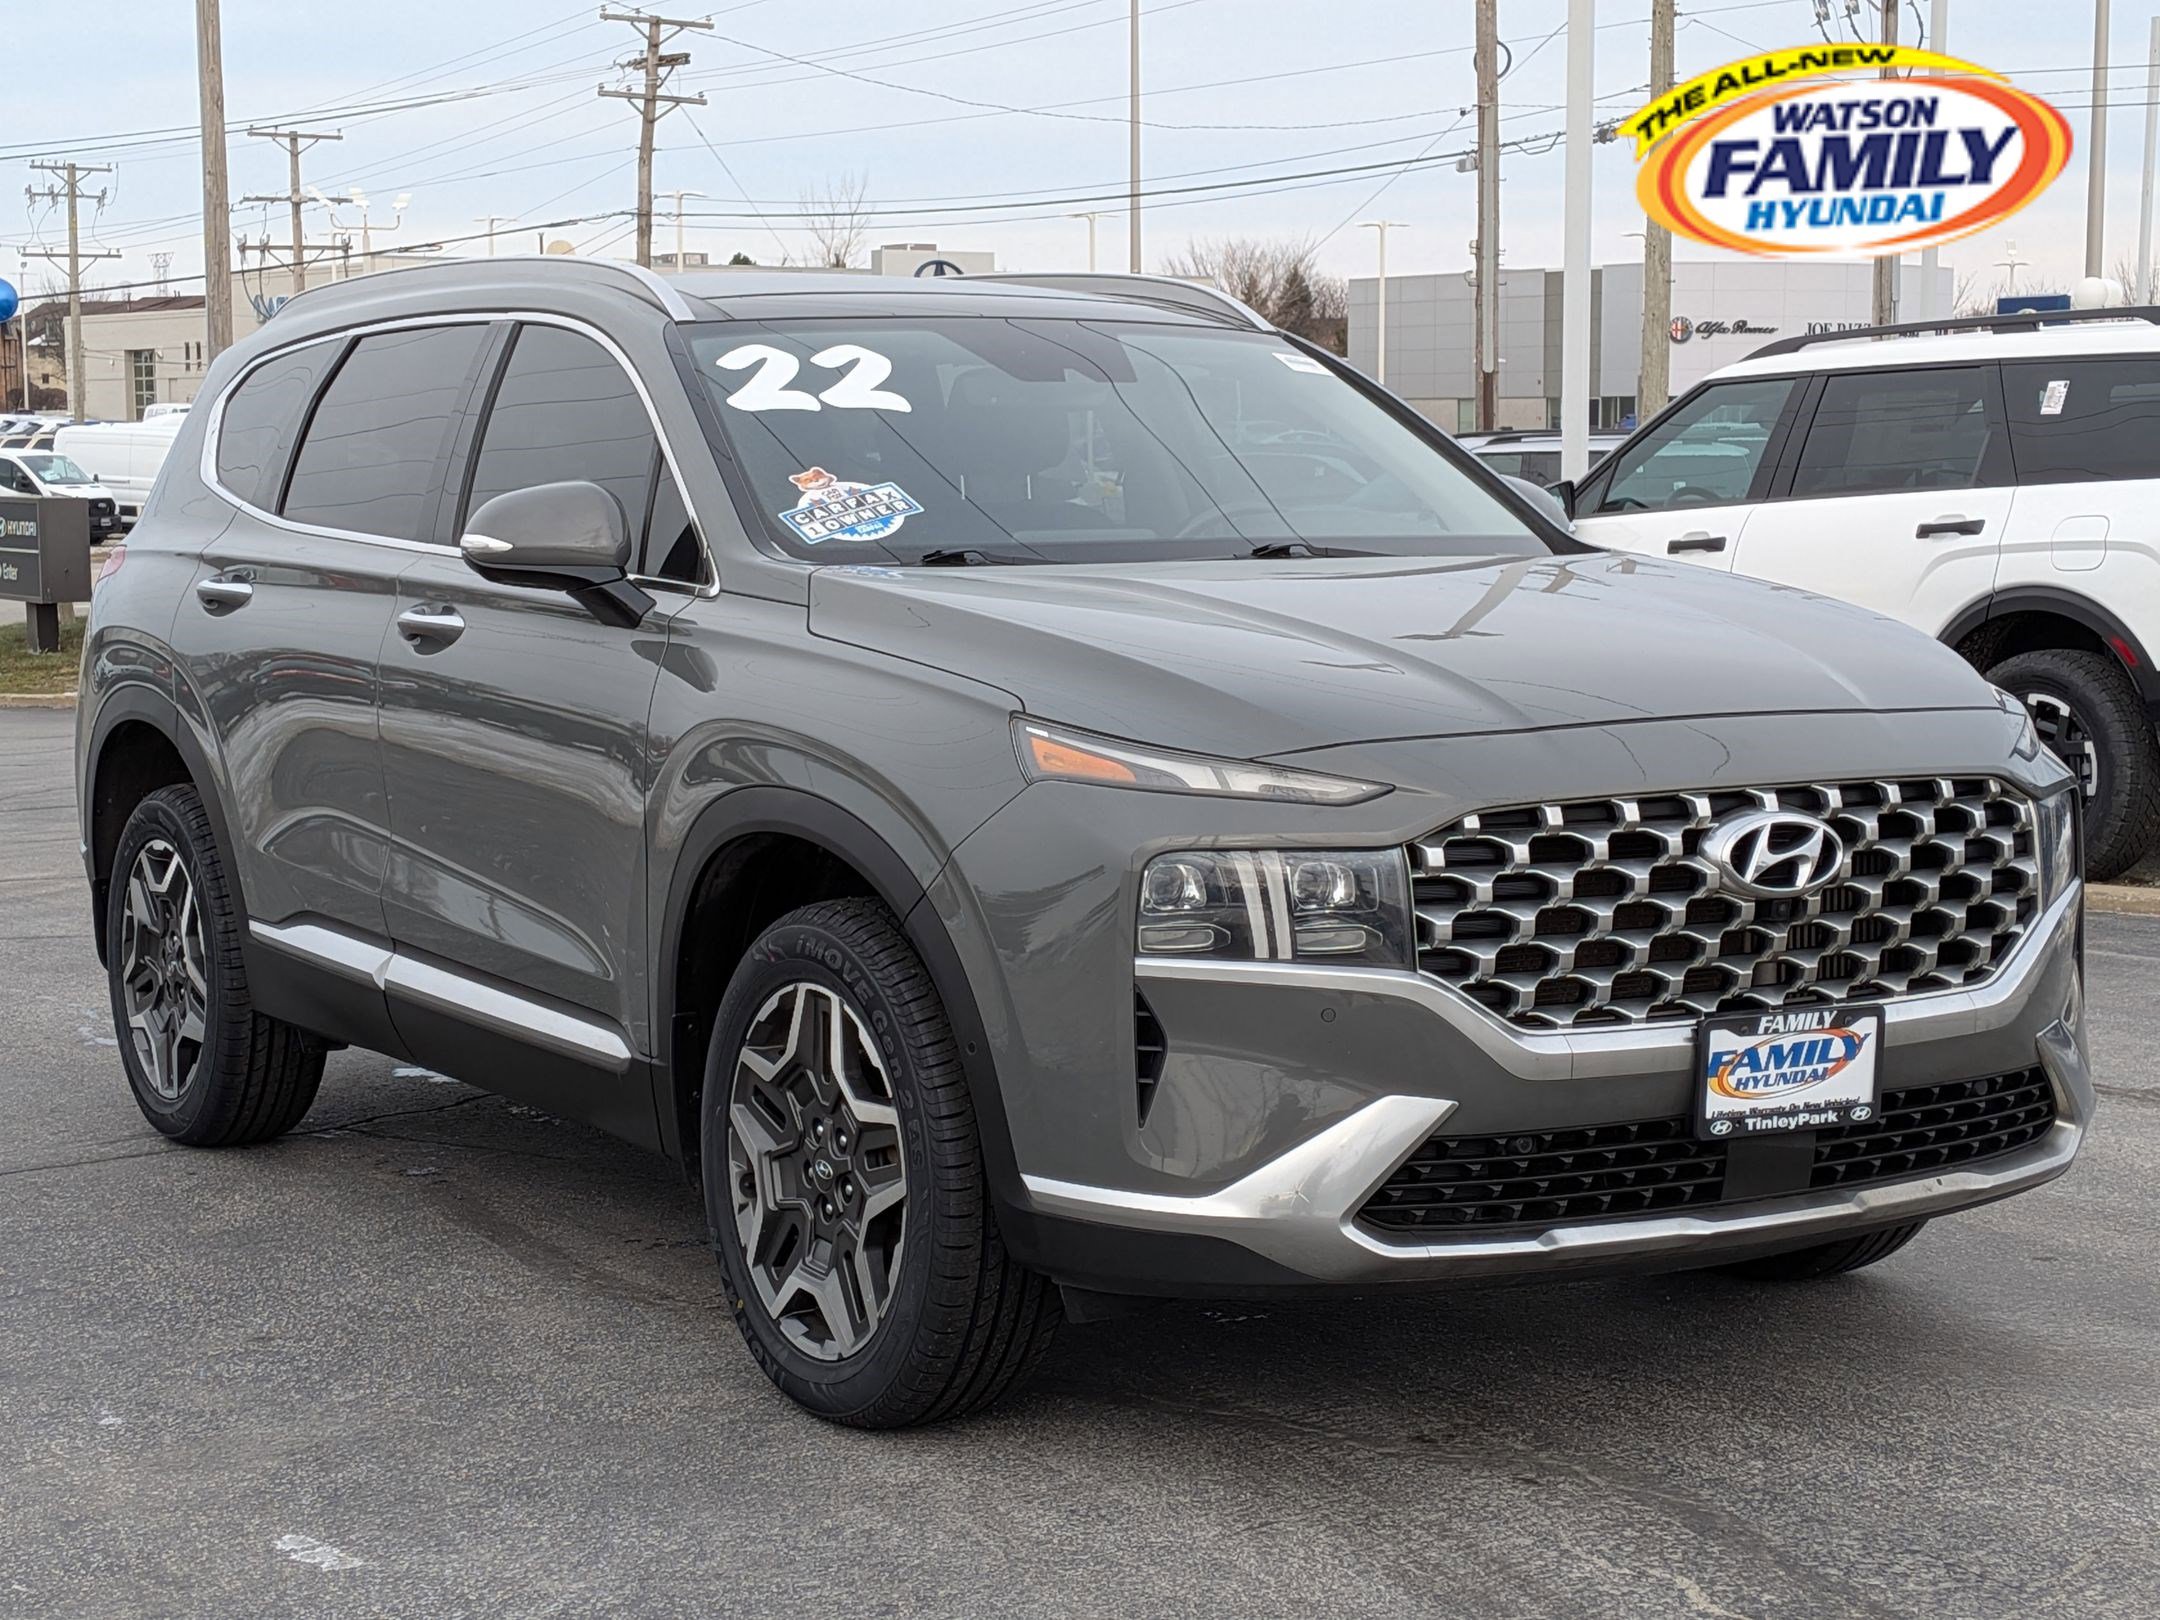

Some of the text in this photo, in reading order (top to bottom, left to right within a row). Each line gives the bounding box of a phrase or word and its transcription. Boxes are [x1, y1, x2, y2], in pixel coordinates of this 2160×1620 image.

[1695, 319, 1779, 340] Alfa Romeo
[1805, 322, 1833, 336] JOE
[715, 344, 912, 413] 22
[794, 490, 897, 523] CARFAX
[825, 500, 910, 530] OWNER
[7, 520, 37, 536] HYUNDAI
[1757, 1010, 1838, 1035] FAMILY
[1708, 1032, 1872, 1078] FAMILY
[1734, 1066, 1829, 1091] HYUNDAI
[1745, 1110, 1838, 1131] TinleyPark
